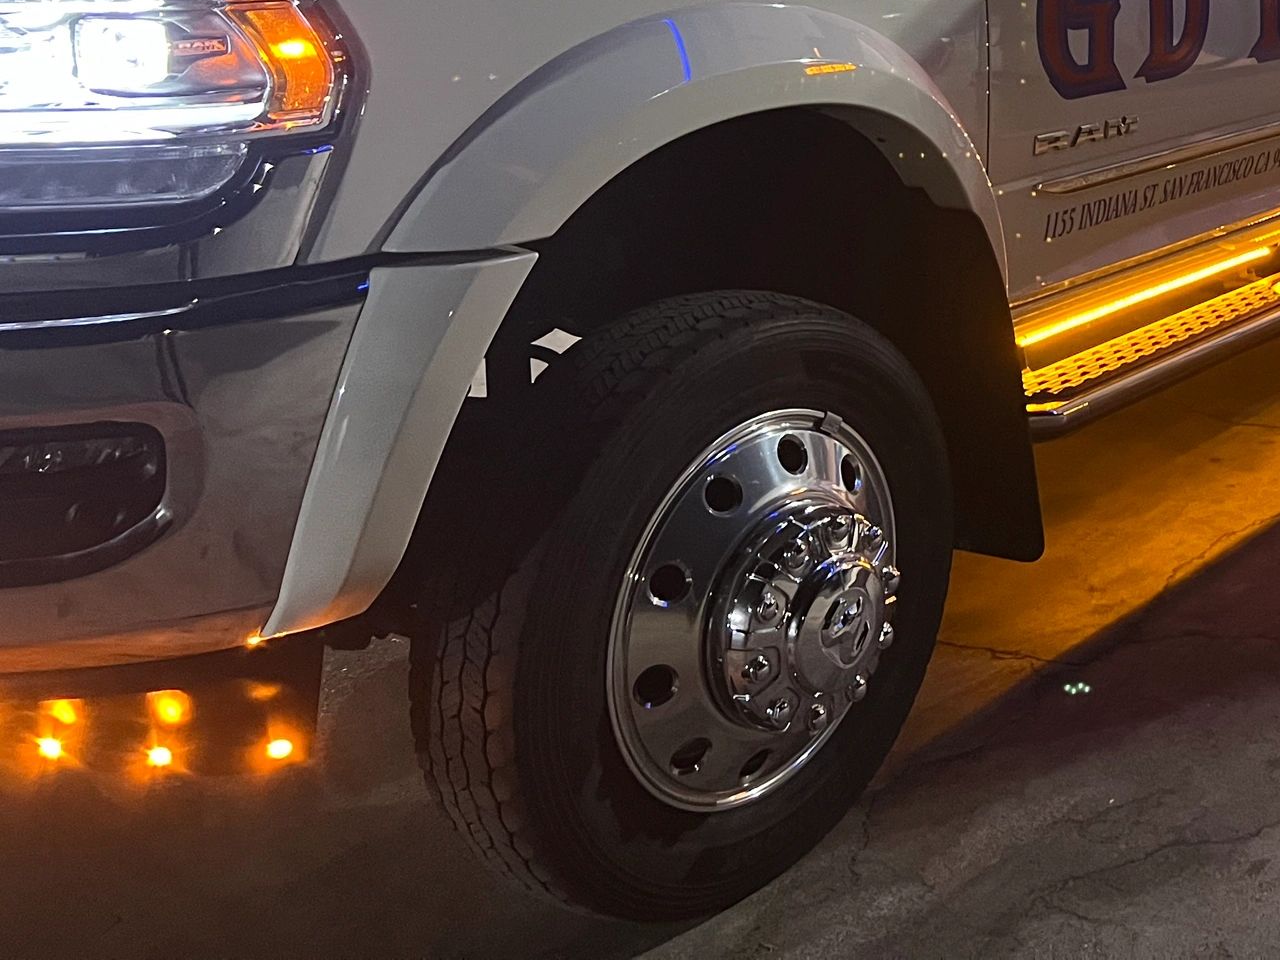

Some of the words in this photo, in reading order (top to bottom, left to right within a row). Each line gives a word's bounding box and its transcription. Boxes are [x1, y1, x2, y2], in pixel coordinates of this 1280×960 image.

[1045, 208, 1077, 241] 1155
[1078, 191, 1138, 230] INDIANA
[1159, 177, 1190, 205] SAN
[1185, 156, 1255, 196] FRANCISCO
[1254, 150, 1273, 178] CA
